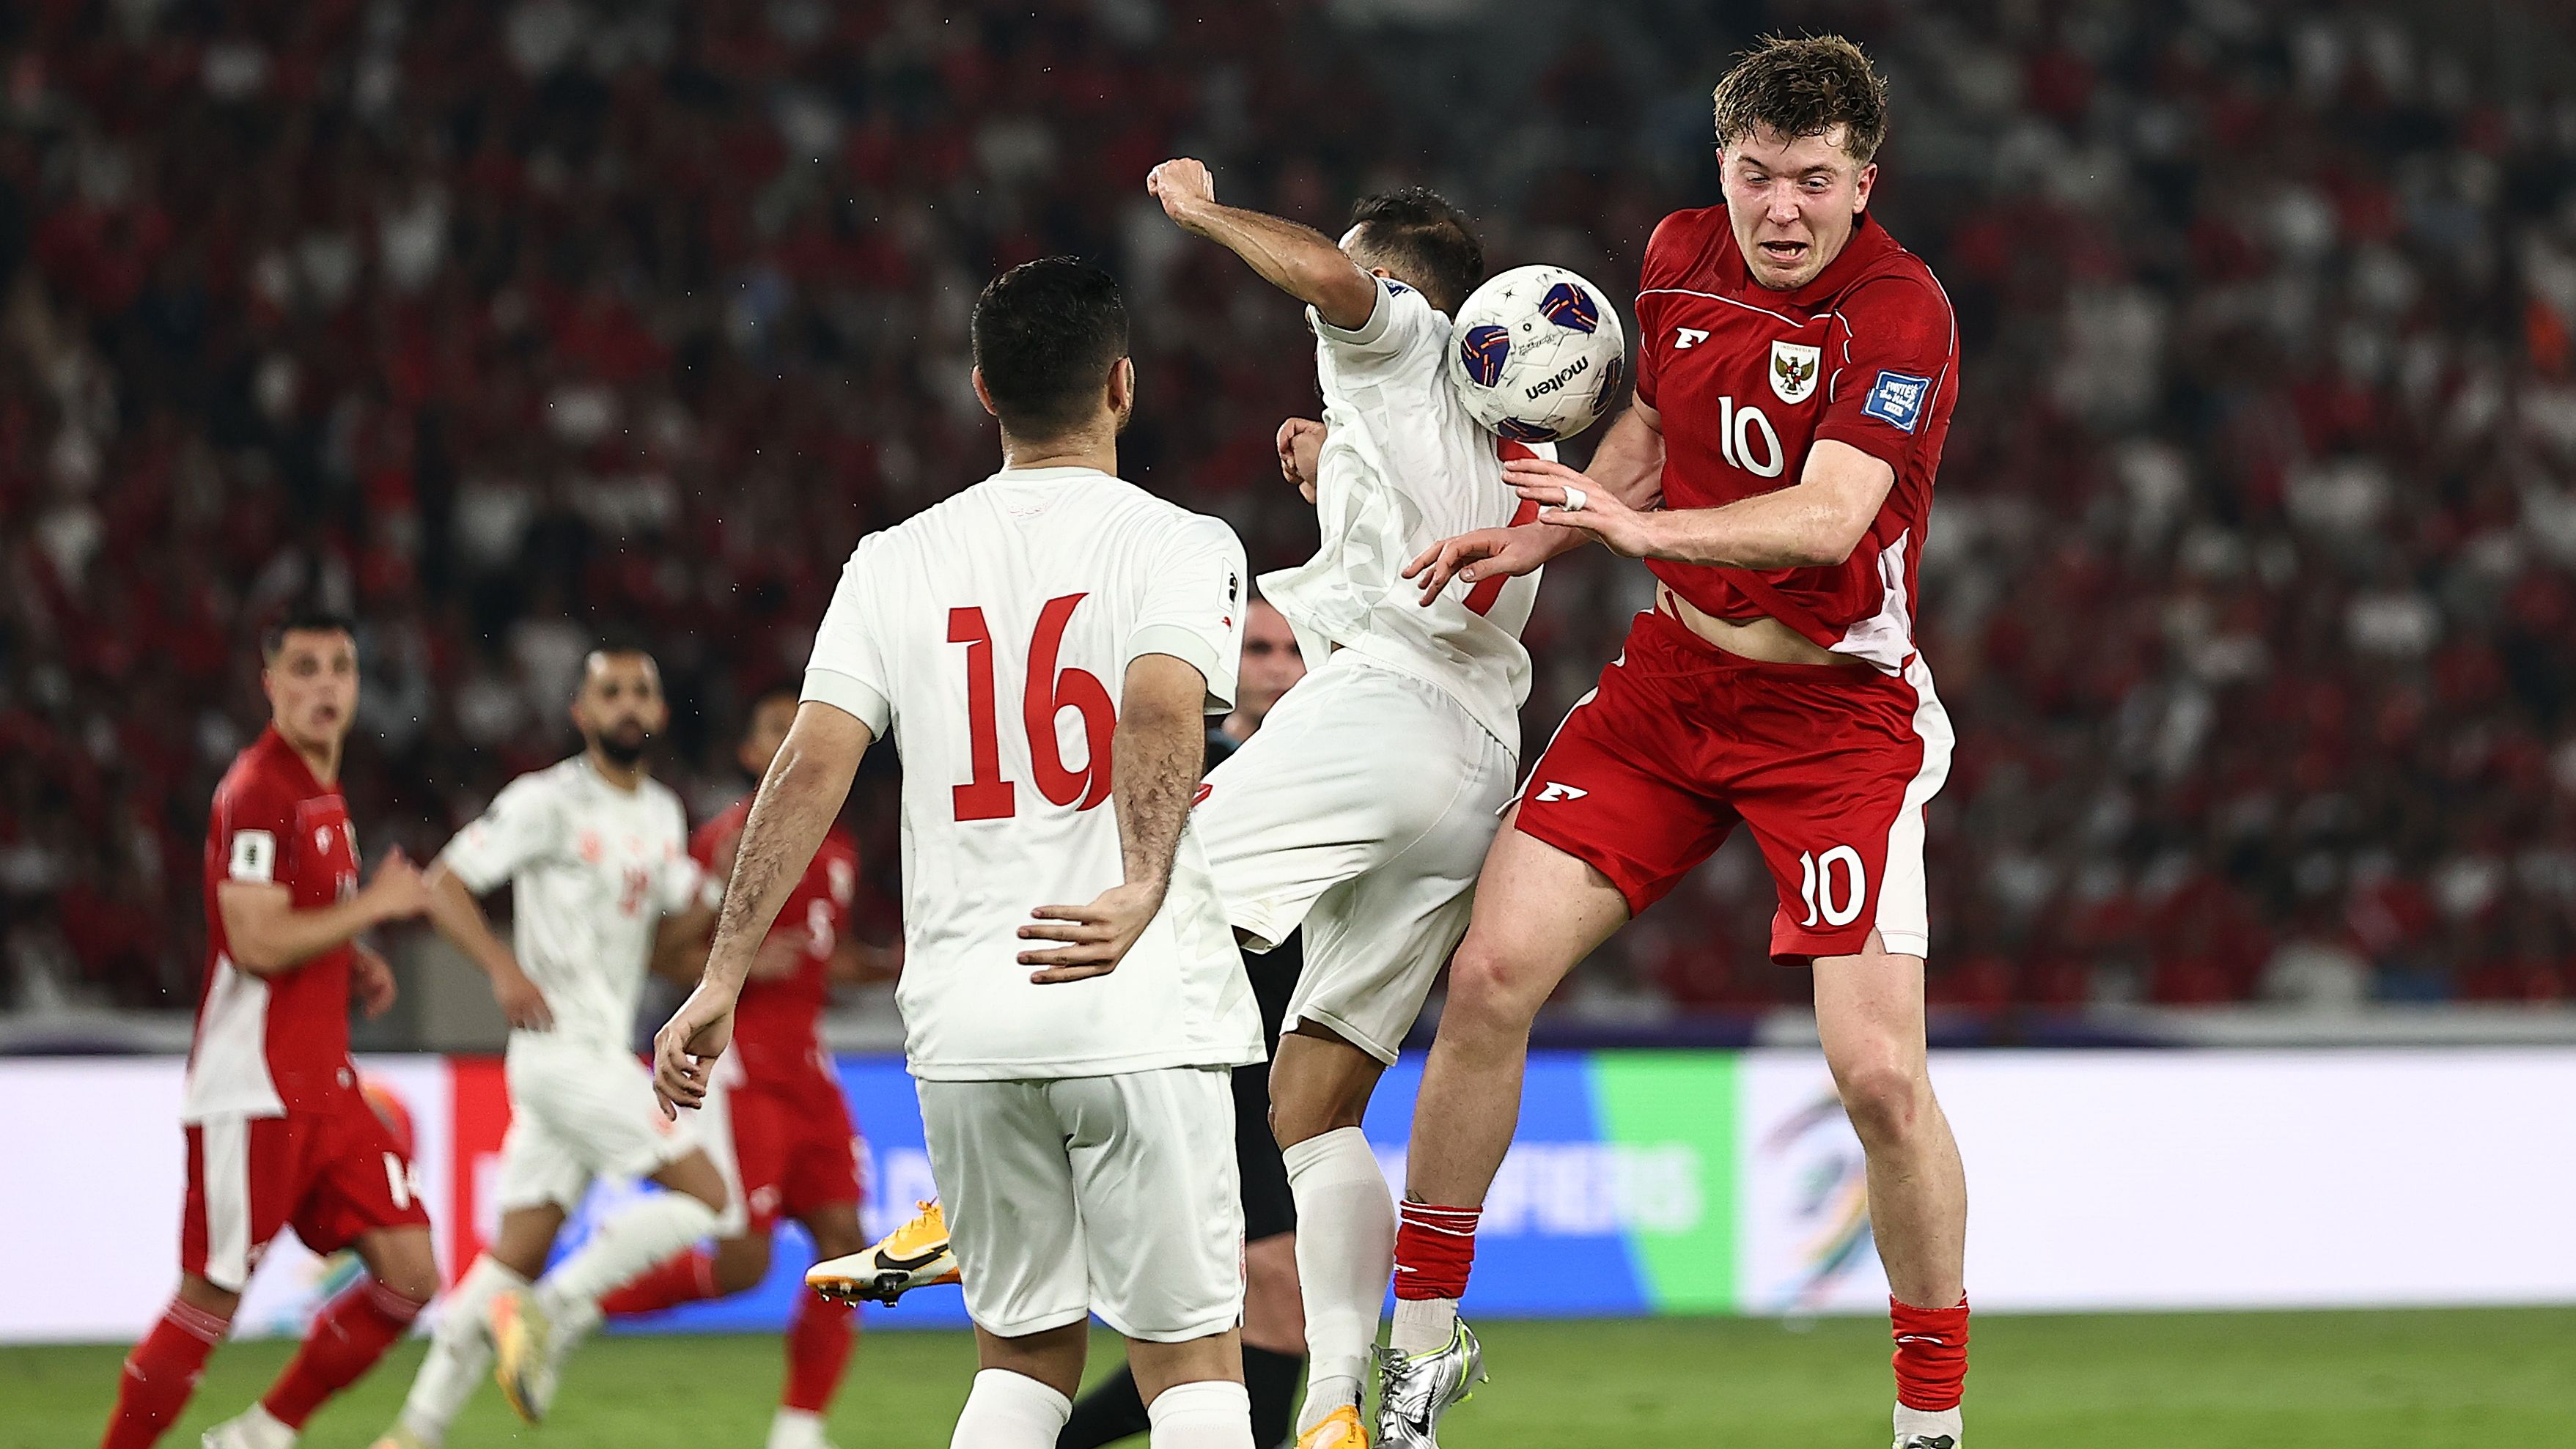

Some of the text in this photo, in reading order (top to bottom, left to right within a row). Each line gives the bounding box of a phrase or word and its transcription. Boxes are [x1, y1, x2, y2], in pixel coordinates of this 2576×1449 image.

[1525, 355, 1589, 399] molten
[1718, 396, 1784, 477] 10
[946, 591, 1117, 822] 16
[1800, 844, 1867, 926] 10
